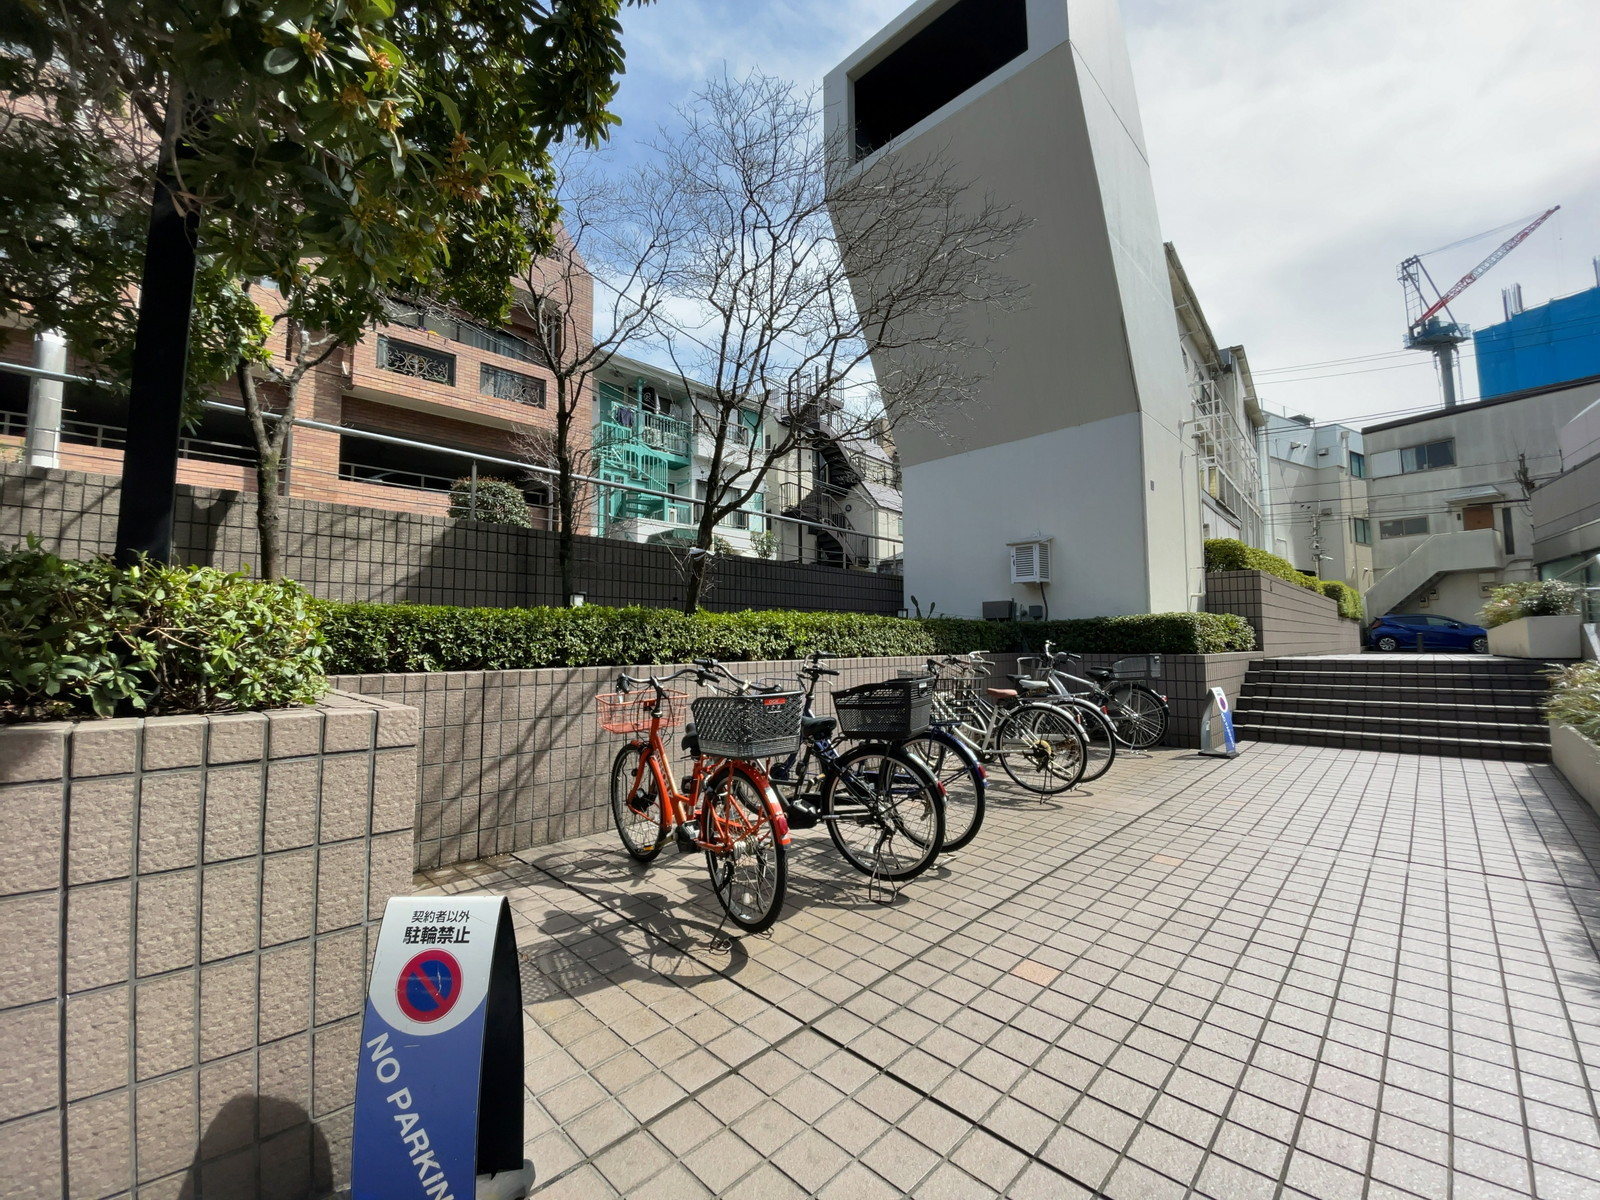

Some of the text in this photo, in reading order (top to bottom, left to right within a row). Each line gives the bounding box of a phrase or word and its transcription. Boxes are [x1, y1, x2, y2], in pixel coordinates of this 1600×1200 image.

[411, 910, 470, 923] 契約者以外
[402, 926, 471, 944] 駐輪禁止
[366, 1032, 401, 1084] NO
